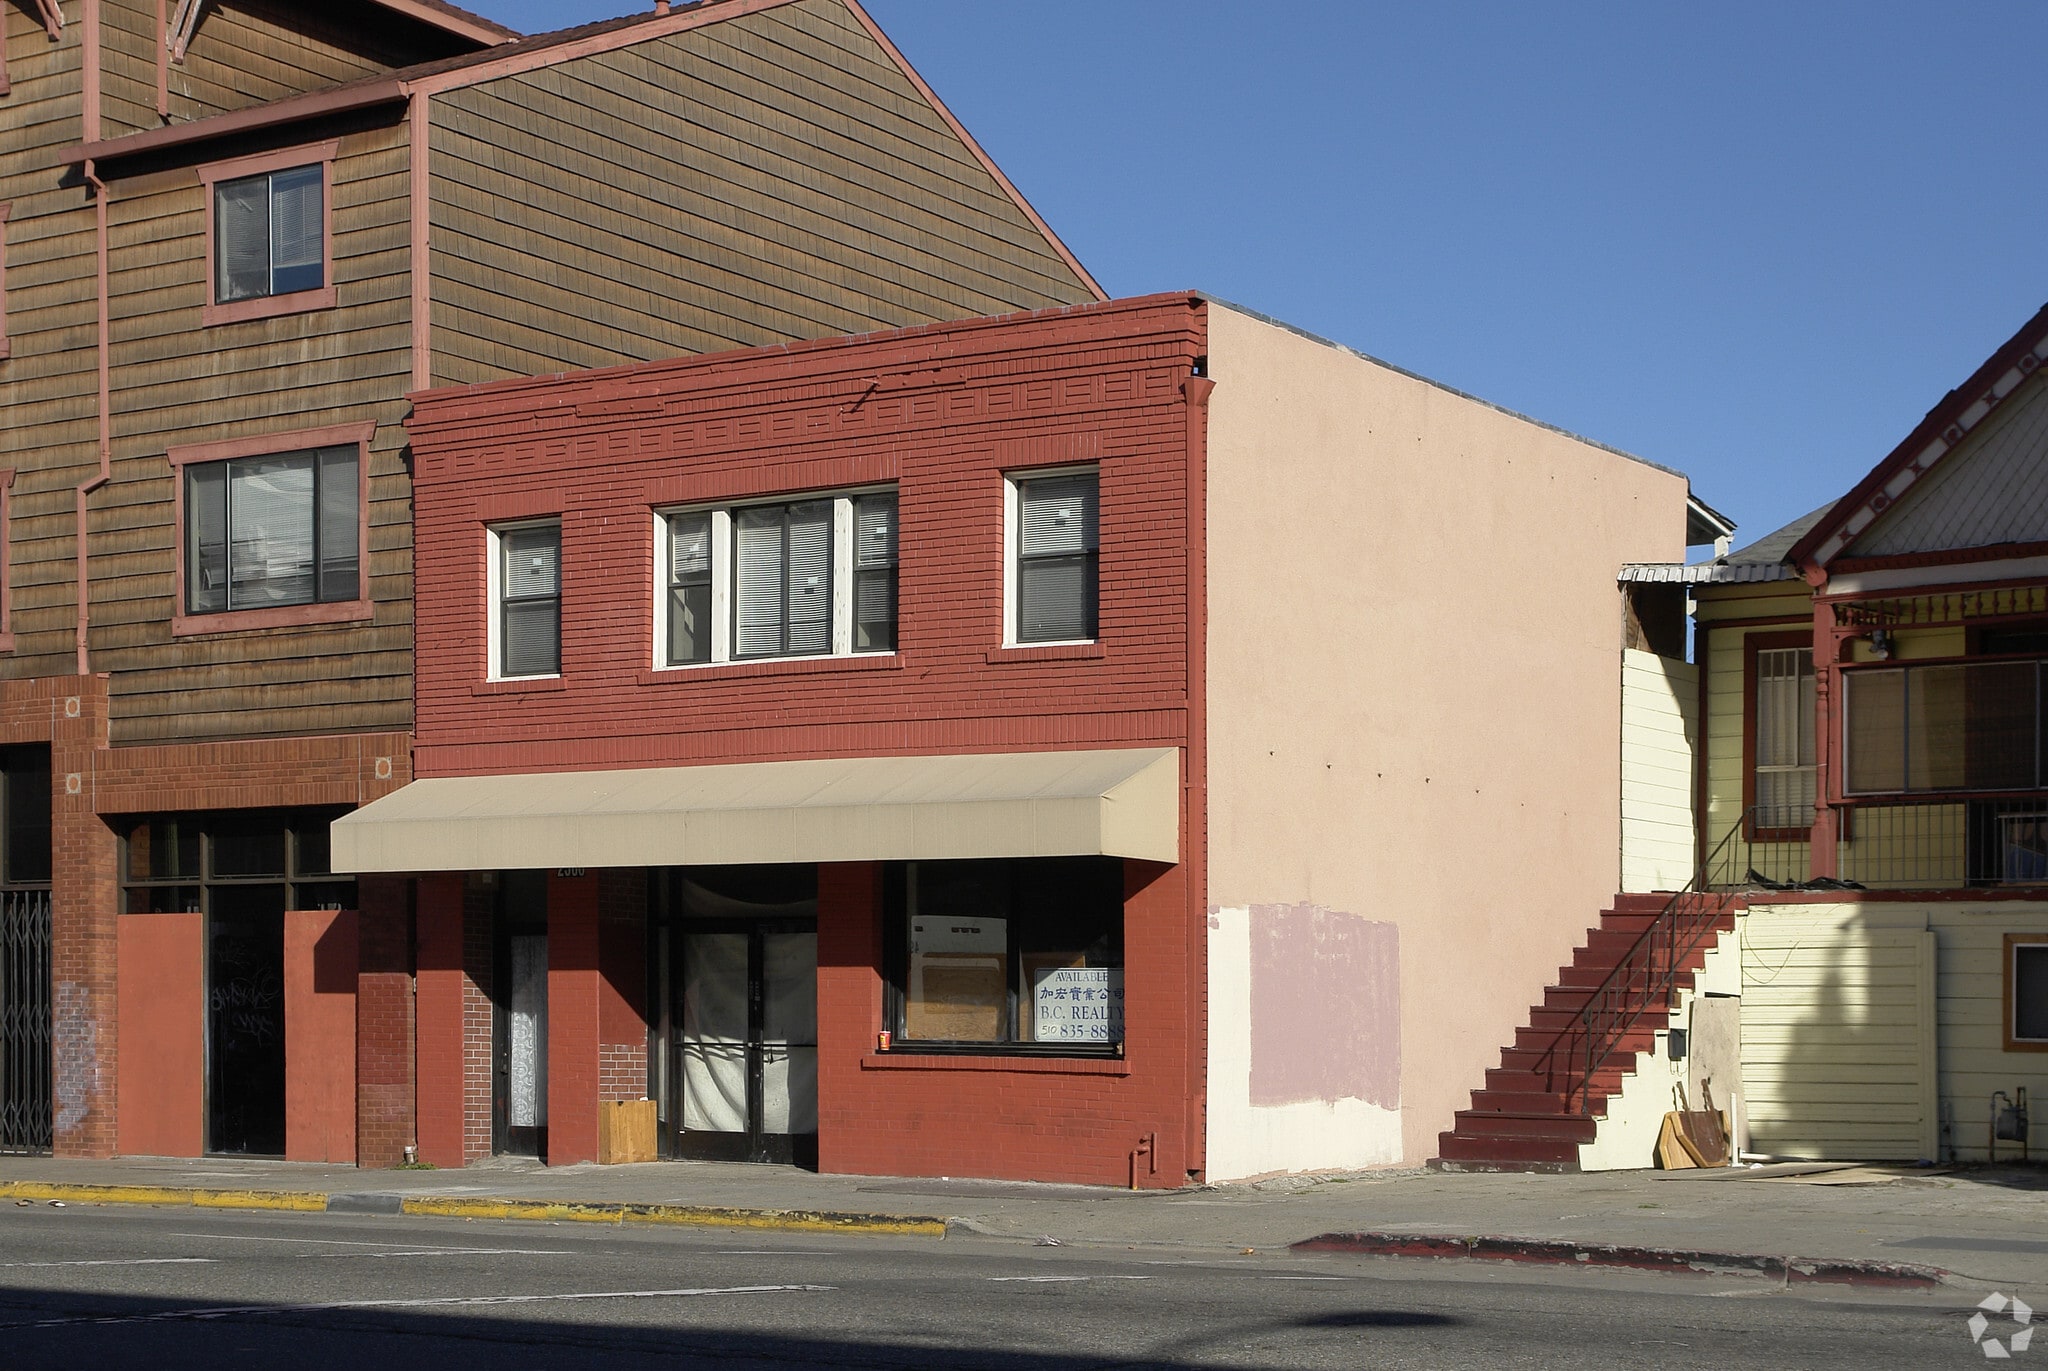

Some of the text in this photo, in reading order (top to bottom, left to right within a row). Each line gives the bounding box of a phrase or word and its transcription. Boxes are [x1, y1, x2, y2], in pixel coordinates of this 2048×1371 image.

[1055, 972, 1109, 982] AVAILABLE
[1041, 1006, 1125, 1020] B.C. REALTY
[1060, 1024, 1125, 1039] 835-8888
